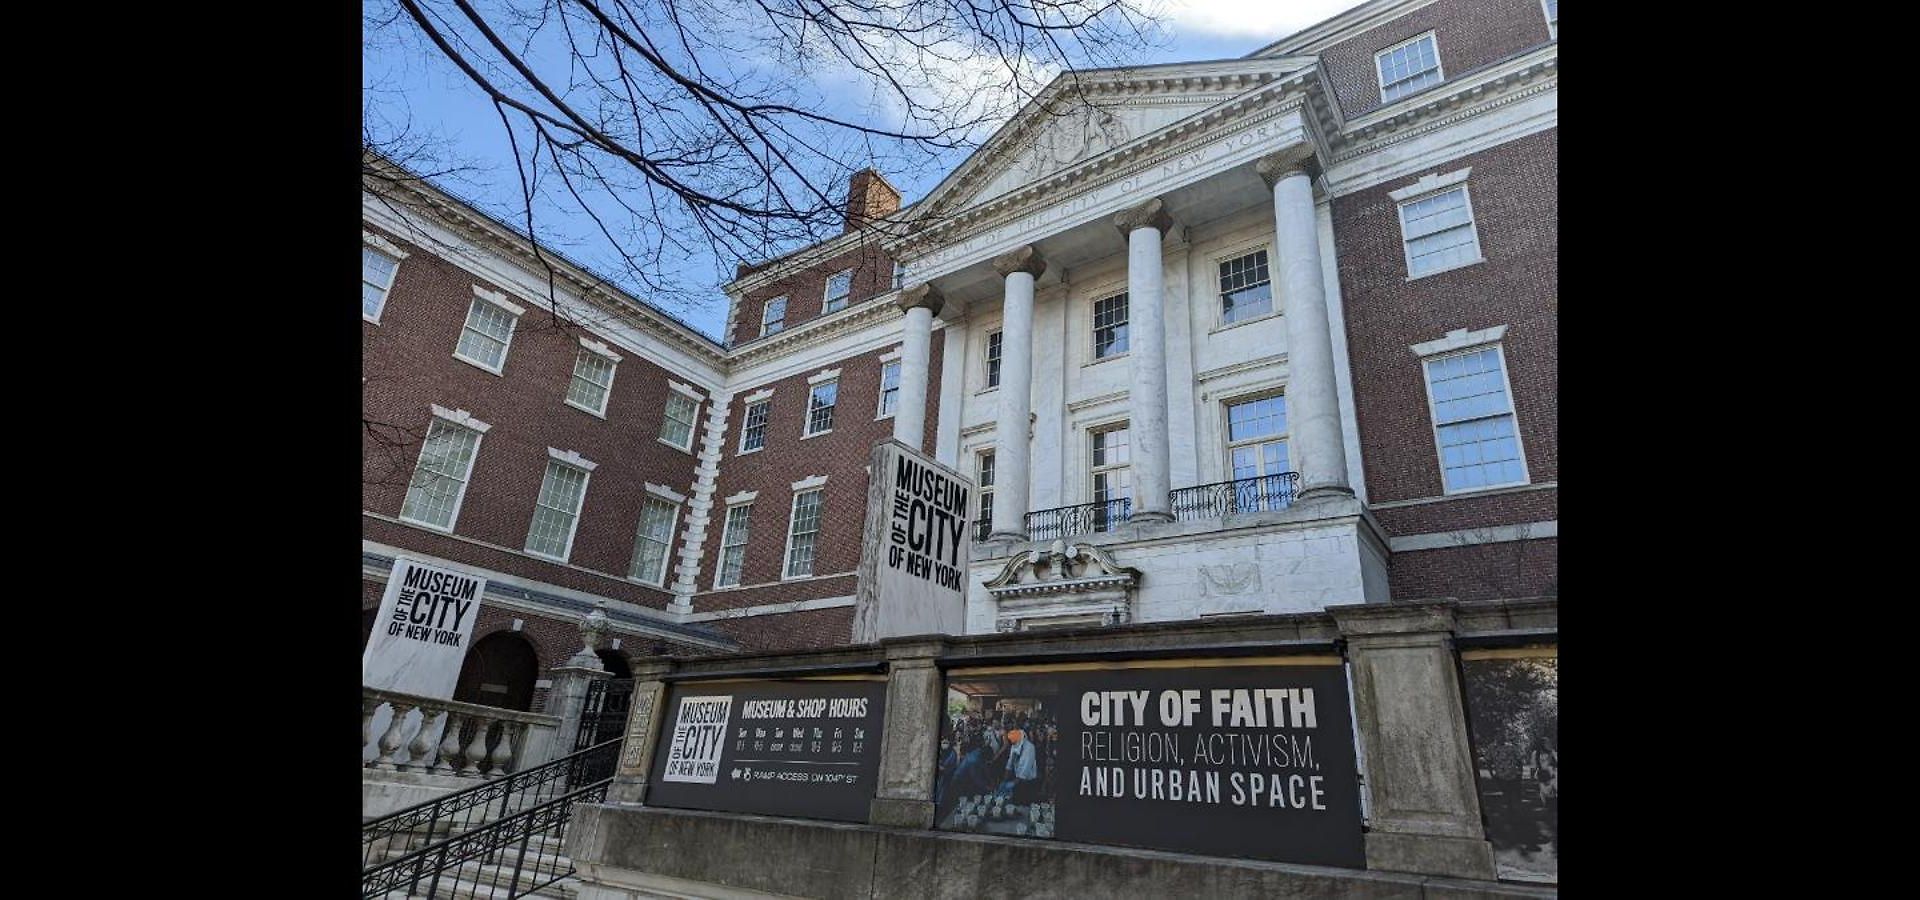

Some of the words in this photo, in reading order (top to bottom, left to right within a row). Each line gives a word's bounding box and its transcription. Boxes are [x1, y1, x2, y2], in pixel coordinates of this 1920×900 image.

[1121, 177, 1145, 193] OF
[1163, 150, 1207, 177] NEW
[1225, 122, 1285, 151] YORK
[896, 455, 968, 519] MUSEUM
[893, 489, 910, 520] THE
[892, 521, 907, 545] OF
[907, 498, 966, 566] CITY
[403, 565, 478, 600] MUSEUM
[888, 545, 904, 570] OF
[906, 551, 932, 581] NEW
[934, 561, 962, 592] YORK
[397, 587, 415, 607] THE
[409, 592, 471, 632] CITY
[393, 607, 408, 621] OF
[388, 621, 405, 636] OF
[405, 624, 432, 640] NEW
[433, 629, 462, 647] YORK
[681, 702, 728, 723] MUSEUM
[742, 700, 787, 719] MUSEUM
[787, 700, 795, 718] &
[797, 699, 826, 718] SHOP
[829, 698, 868, 718] HOURS
[1080, 690, 1150, 727] CITY
[1159, 689, 1201, 727] OF
[1211, 688, 1318, 728] FAITH
[676, 726, 687, 742] THE
[683, 725, 723, 760] CITY
[672, 746, 681, 759] OF
[1081, 731, 1185, 766] RELIGION,
[1194, 733, 1321, 771] ACTIVISM,
[679, 761, 695, 776] NEW
[696, 762, 715, 776] YORK
[753, 771, 775, 780] RAMP
[777, 772, 808, 781] ACCESS
[811, 773, 823, 782] ON
[1079, 766, 1126, 798] AND
[1134, 769, 1221, 804] URBAN
[1230, 772, 1327, 811] SPACE
